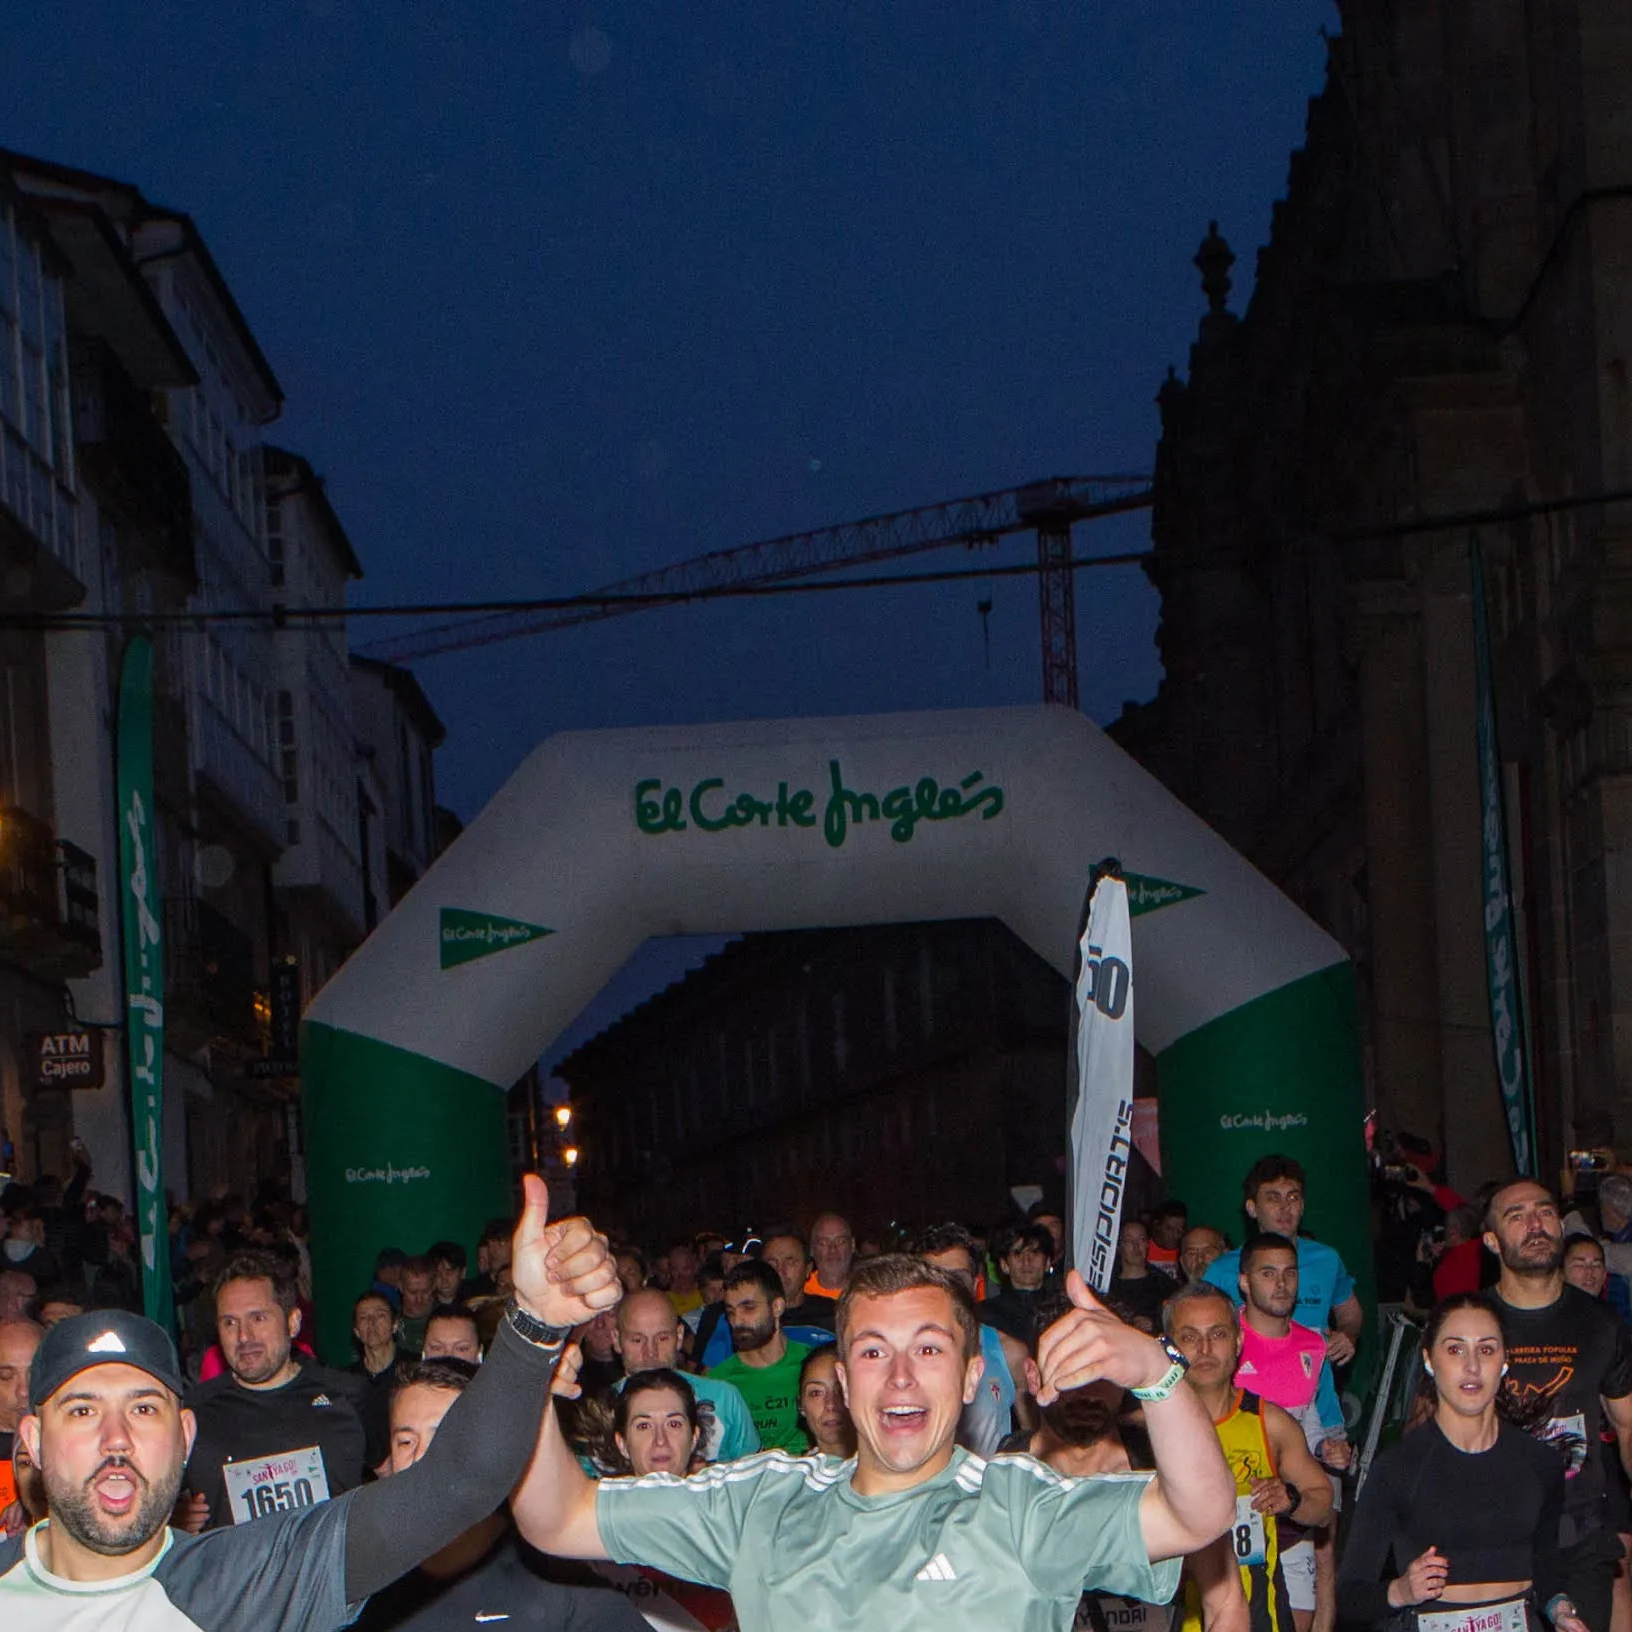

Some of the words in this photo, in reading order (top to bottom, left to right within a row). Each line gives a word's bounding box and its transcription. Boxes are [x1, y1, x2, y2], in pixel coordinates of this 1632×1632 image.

[635, 778, 687, 834] El
[689, 777, 817, 832] Corte
[823, 759, 1005, 848] Inglés
[41, 1035, 91, 1056] ATM
[41, 1058, 92, 1080] Cajero
[240, 1475, 316, 1523] 1650
